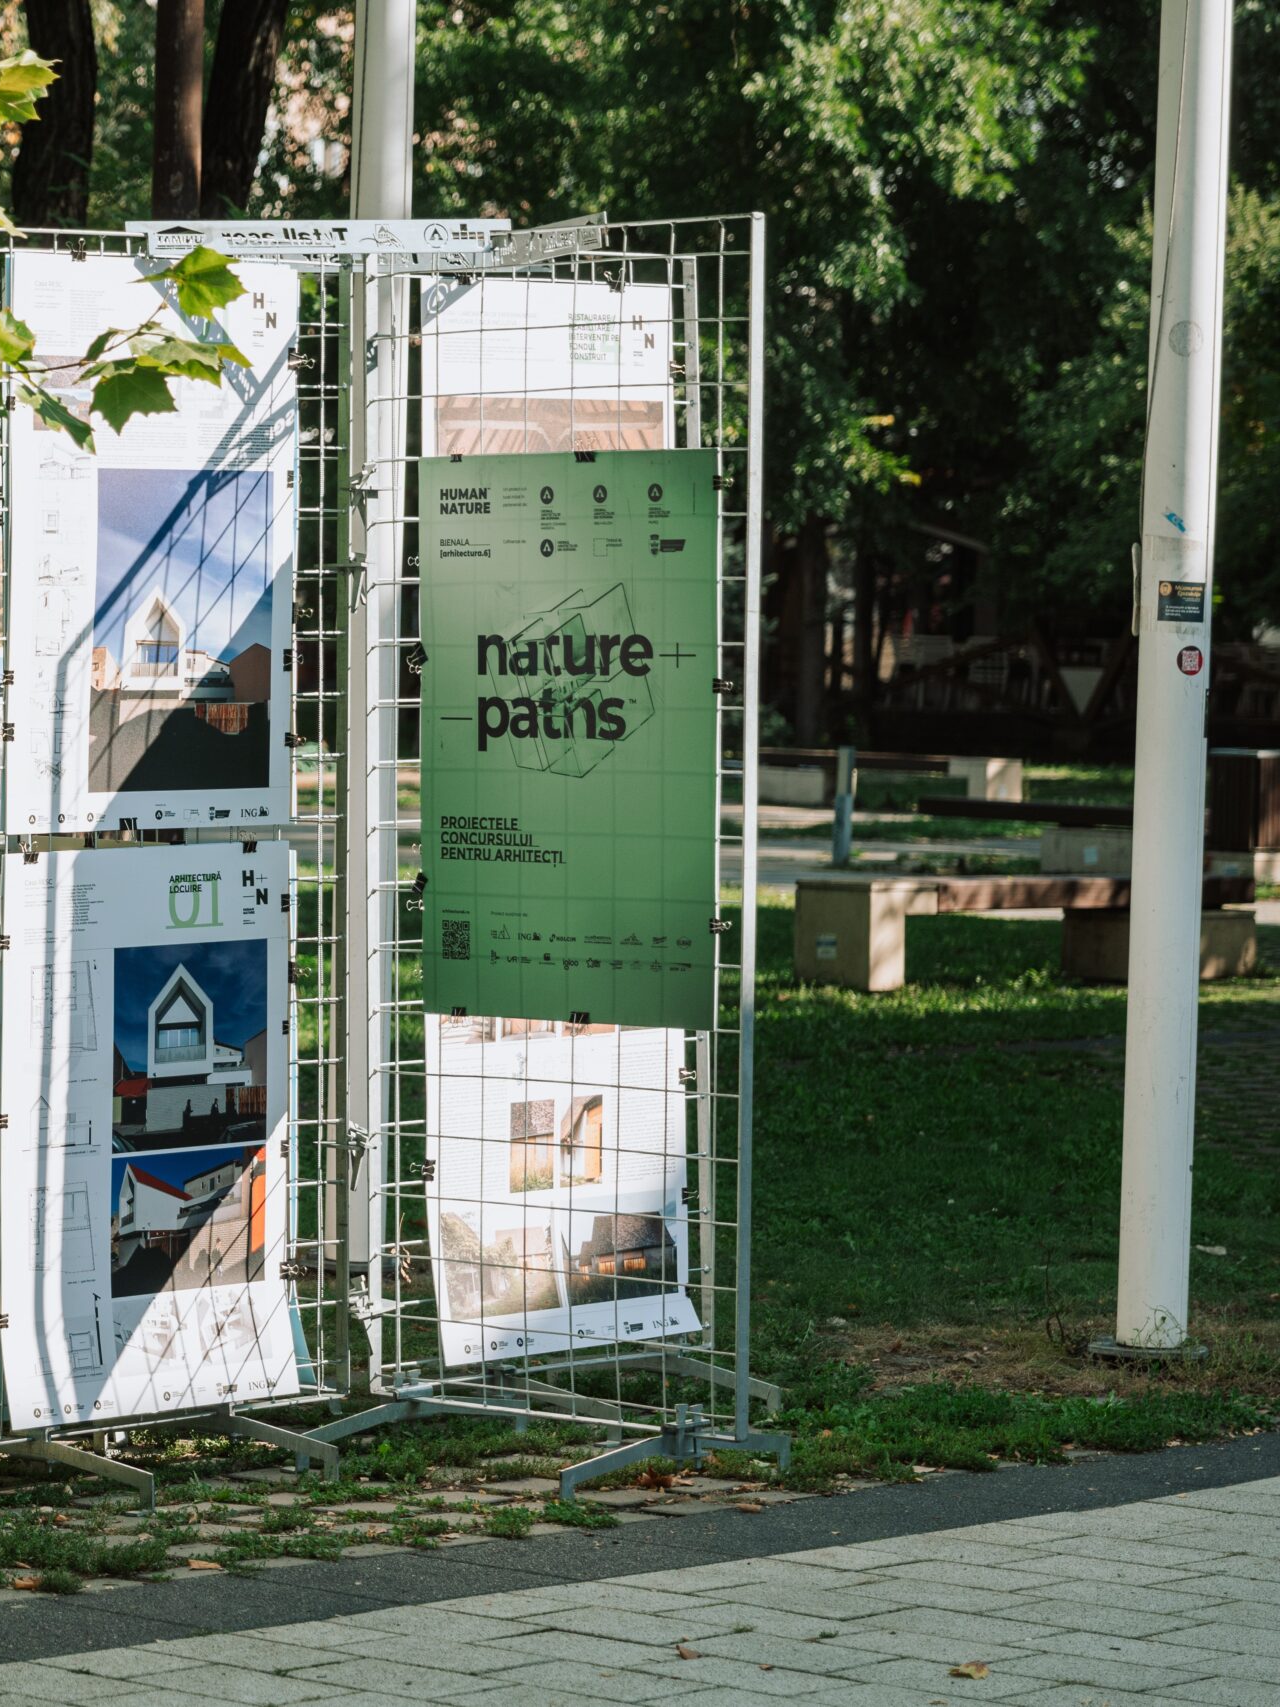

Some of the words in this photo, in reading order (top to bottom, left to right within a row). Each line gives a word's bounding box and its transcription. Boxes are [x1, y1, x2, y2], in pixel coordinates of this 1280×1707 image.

[440, 488, 488, 500] HUMAN
[440, 502, 491, 515] NATURE
[440, 539, 469, 547] BIENALA
[477, 633, 654, 677] nature
[477, 687, 627, 752] paths
[240, 808, 258, 818] ING
[440, 816, 518, 830] PROIECTELE
[440, 831, 533, 846] CONCURSULUI
[440, 847, 492, 861] PENTRU
[495, 849, 563, 867] ARHITECȚI
[169, 871, 222, 884] ARHITECTURĂ
[169, 884, 202, 894] LOCUIRE
[517, 933, 532, 941] ING
[652, 1319, 670, 1330] ING
[248, 1381, 266, 1391] ING
